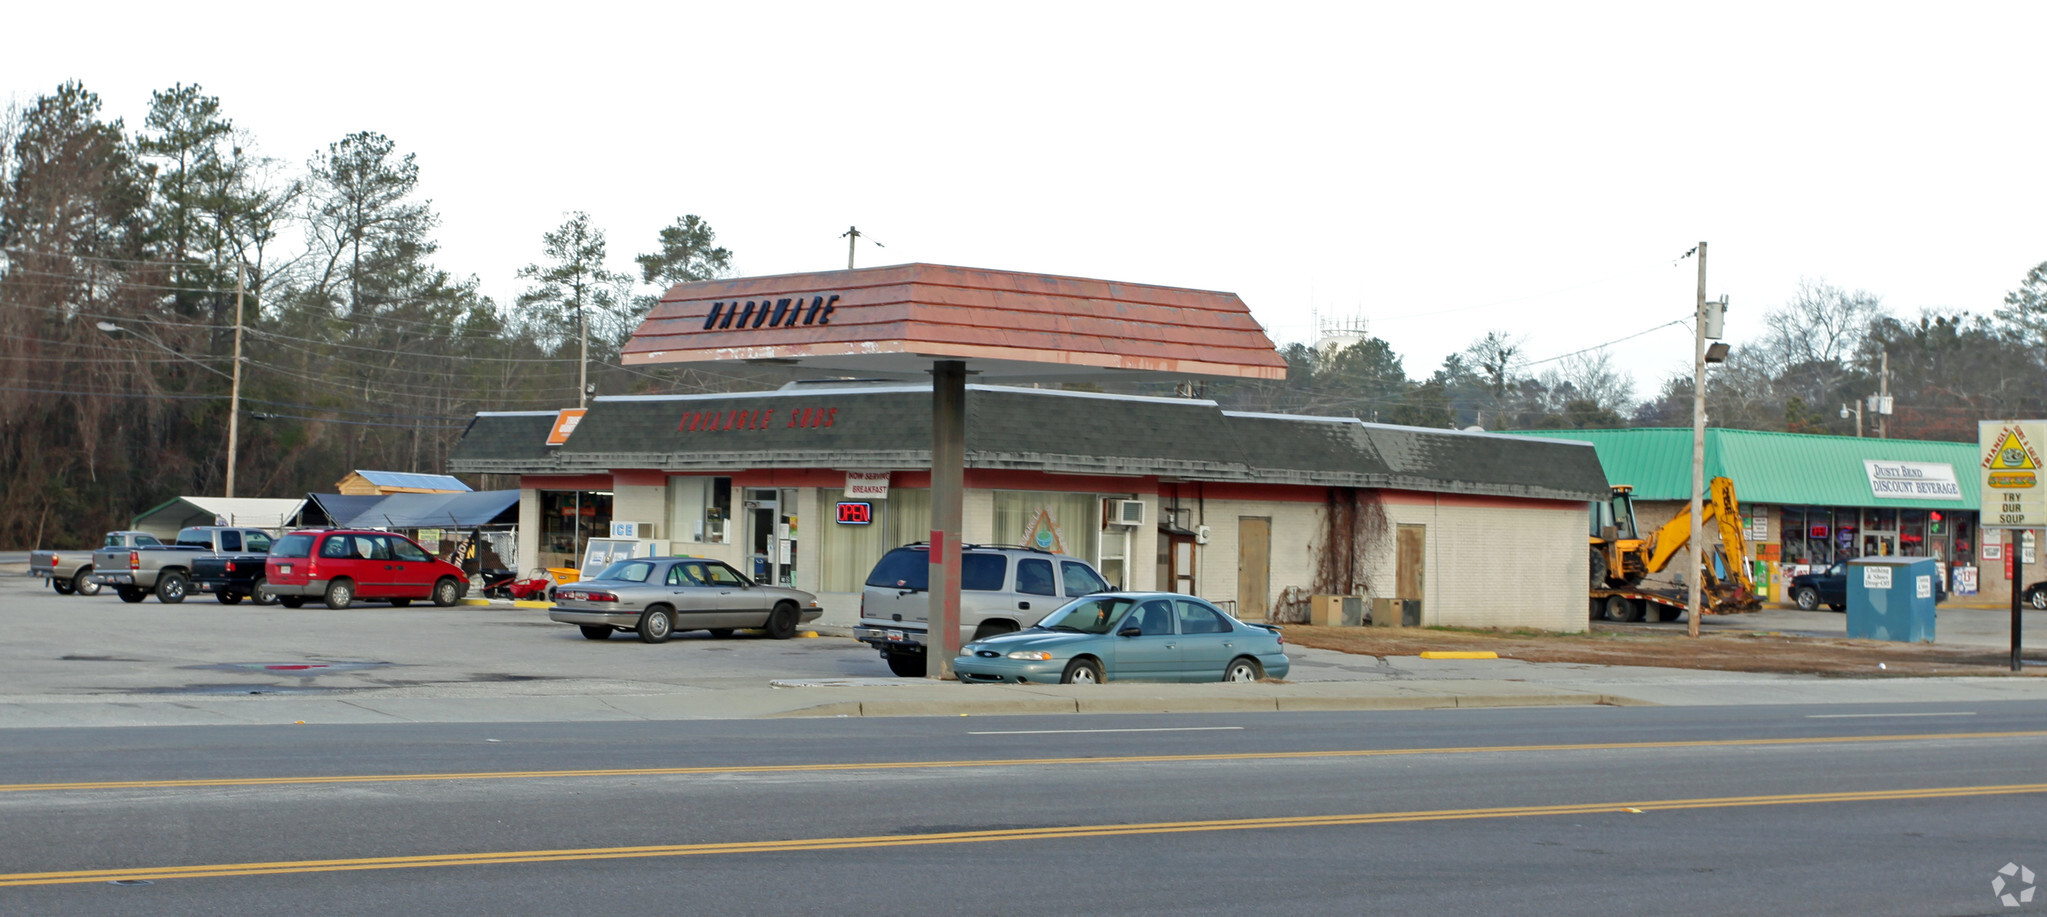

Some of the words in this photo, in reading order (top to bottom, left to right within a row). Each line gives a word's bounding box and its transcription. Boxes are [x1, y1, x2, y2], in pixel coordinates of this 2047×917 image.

[703, 294, 840, 330] HARDWARE
[677, 409, 775, 432] TRIANGLE
[787, 407, 838, 430] SUBS
[1981, 426, 2009, 469] TRIANGLE
[848, 472, 863, 480] NOW
[852, 485, 887, 493] BREAKFAST
[1872, 480, 1914, 493] DISCOUNT
[1915, 482, 1958, 495] BEVERAGE
[2003, 492, 2021, 502] TRY
[838, 504, 870, 522] OPEN
[2002, 503, 2021, 513] OUR
[1999, 514, 2025, 524] SOUP
[611, 523, 633, 536] ICE
[1866, 567, 1889, 575] Clothing
